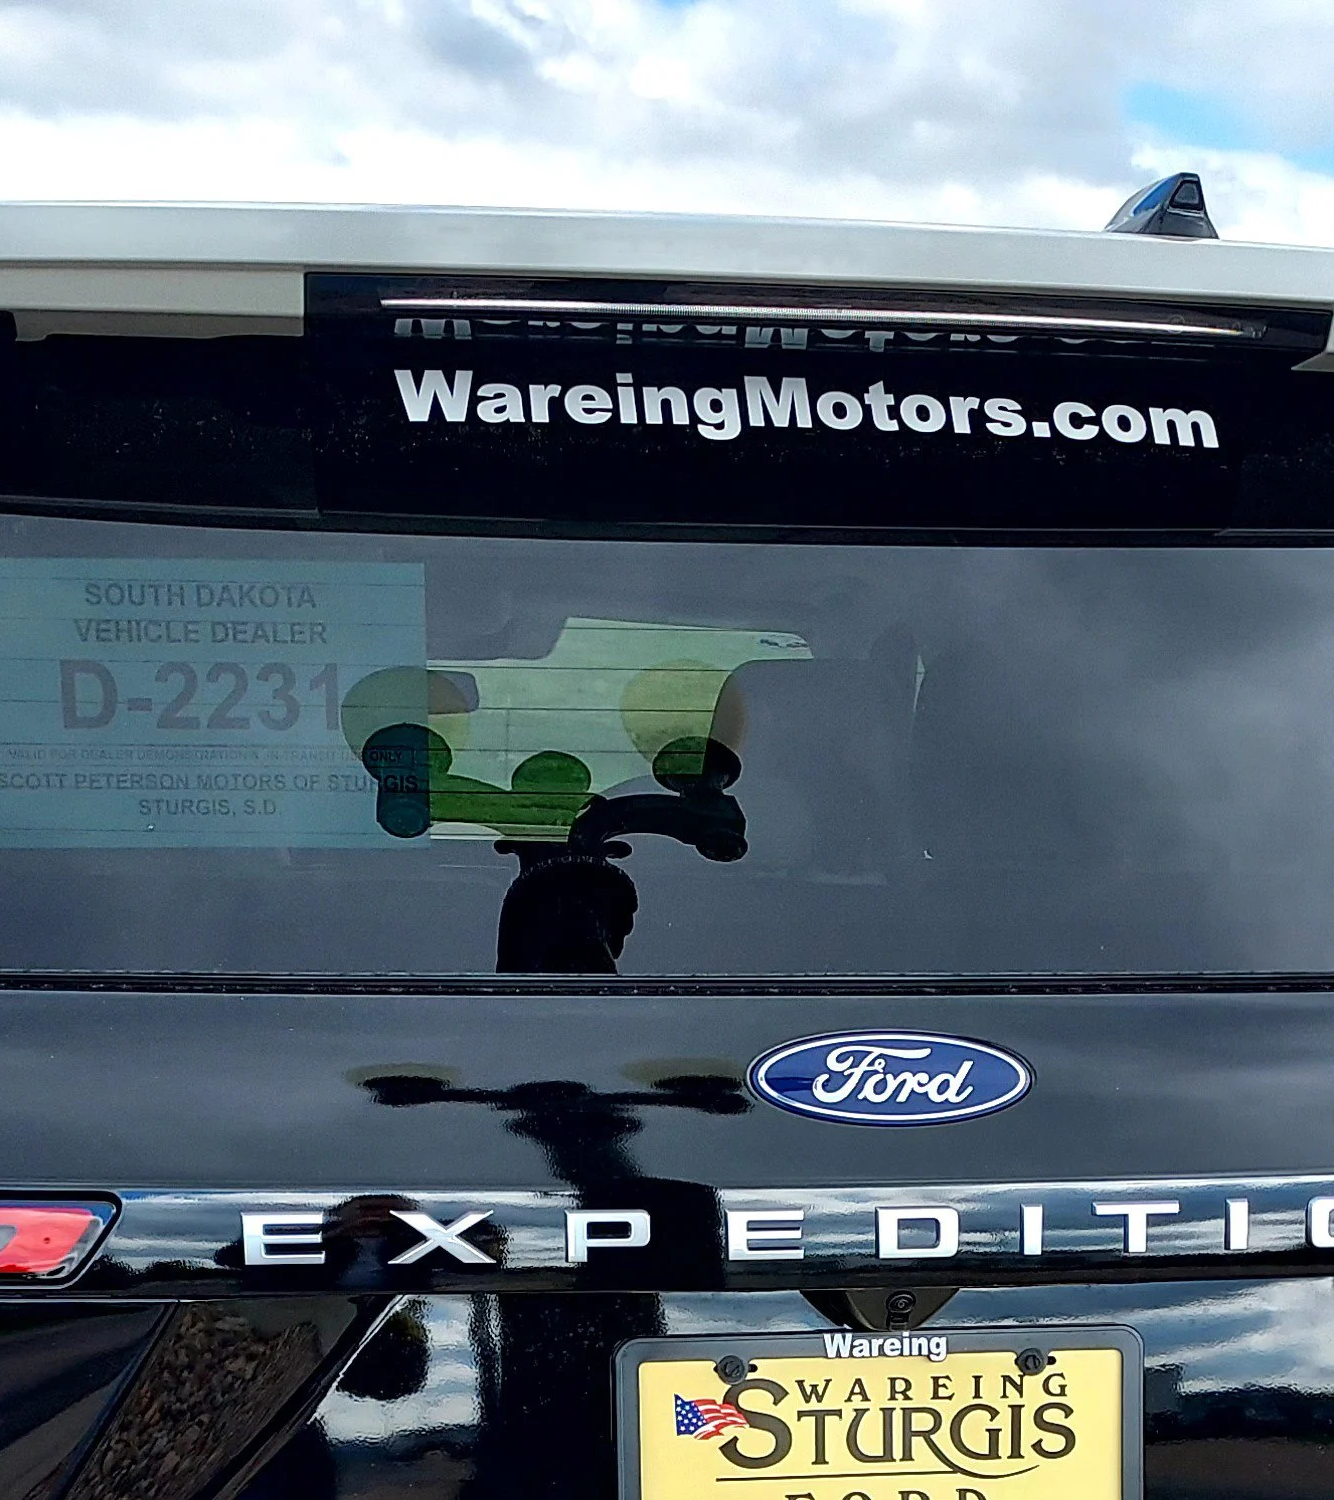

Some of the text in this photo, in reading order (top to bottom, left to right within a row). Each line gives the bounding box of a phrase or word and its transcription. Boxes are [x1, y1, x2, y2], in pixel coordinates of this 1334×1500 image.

[393, 369, 1220, 449] WareingMotors.com
[84, 582, 317, 610] SOUTH DAKOTA
[72, 617, 328, 646] VEHICLE DEALER
[58, 658, 341, 731] D-2231
[369, 750, 403, 761] ONLY
[73, 772, 188, 791] PETERSON
[196, 772, 286, 791] MOTORS
[293, 773, 320, 791] OF
[138, 798, 236, 818] STURGIS,
[812, 1045, 974, 1104] Ford
[823, 1333, 949, 1361] Wareing
[795, 1372, 1070, 1404] WAREING
[715, 1378, 1078, 1478] STURGIS
